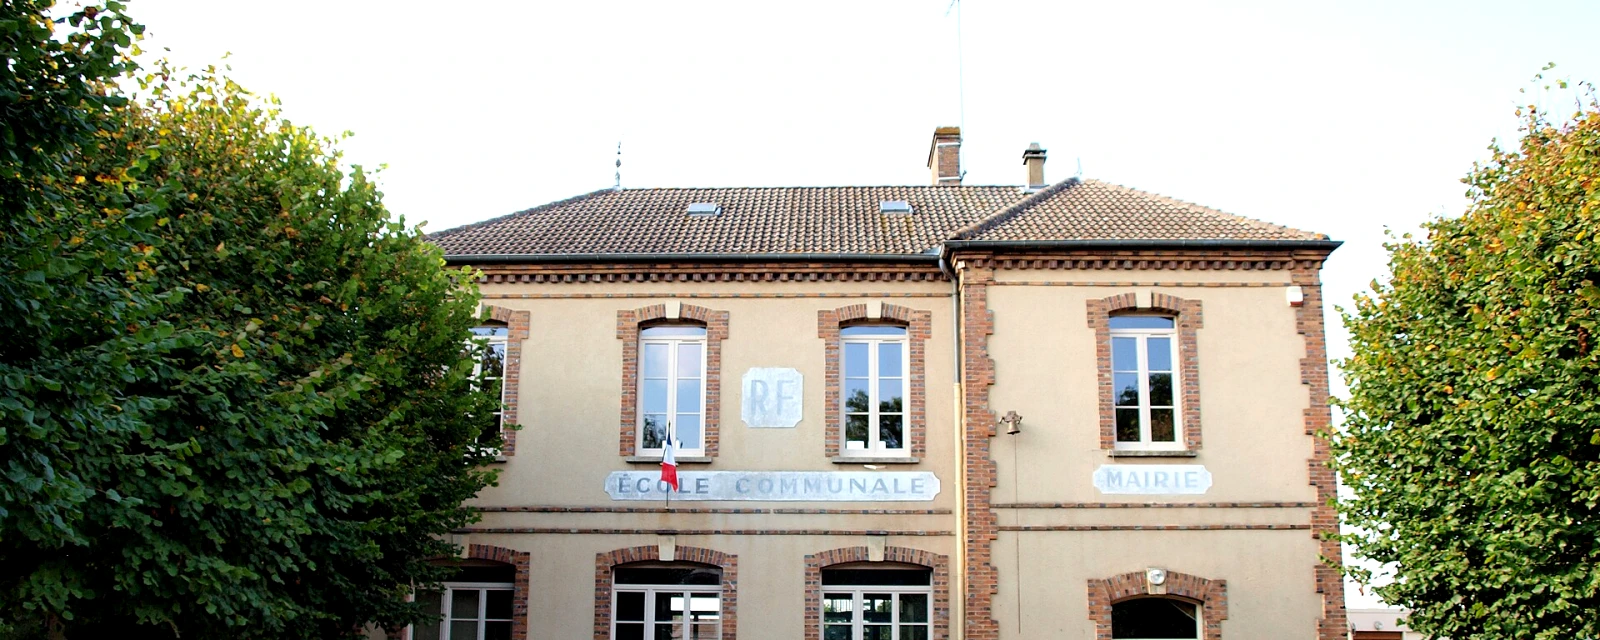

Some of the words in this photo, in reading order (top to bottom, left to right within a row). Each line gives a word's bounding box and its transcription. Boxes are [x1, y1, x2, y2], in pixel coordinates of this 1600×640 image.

[750, 380, 795, 415] RF
[618, 473, 710, 494] ÉCOLE
[735, 478, 925, 494] COMMUNALE
[1107, 471, 1198, 488] MAIRIE
